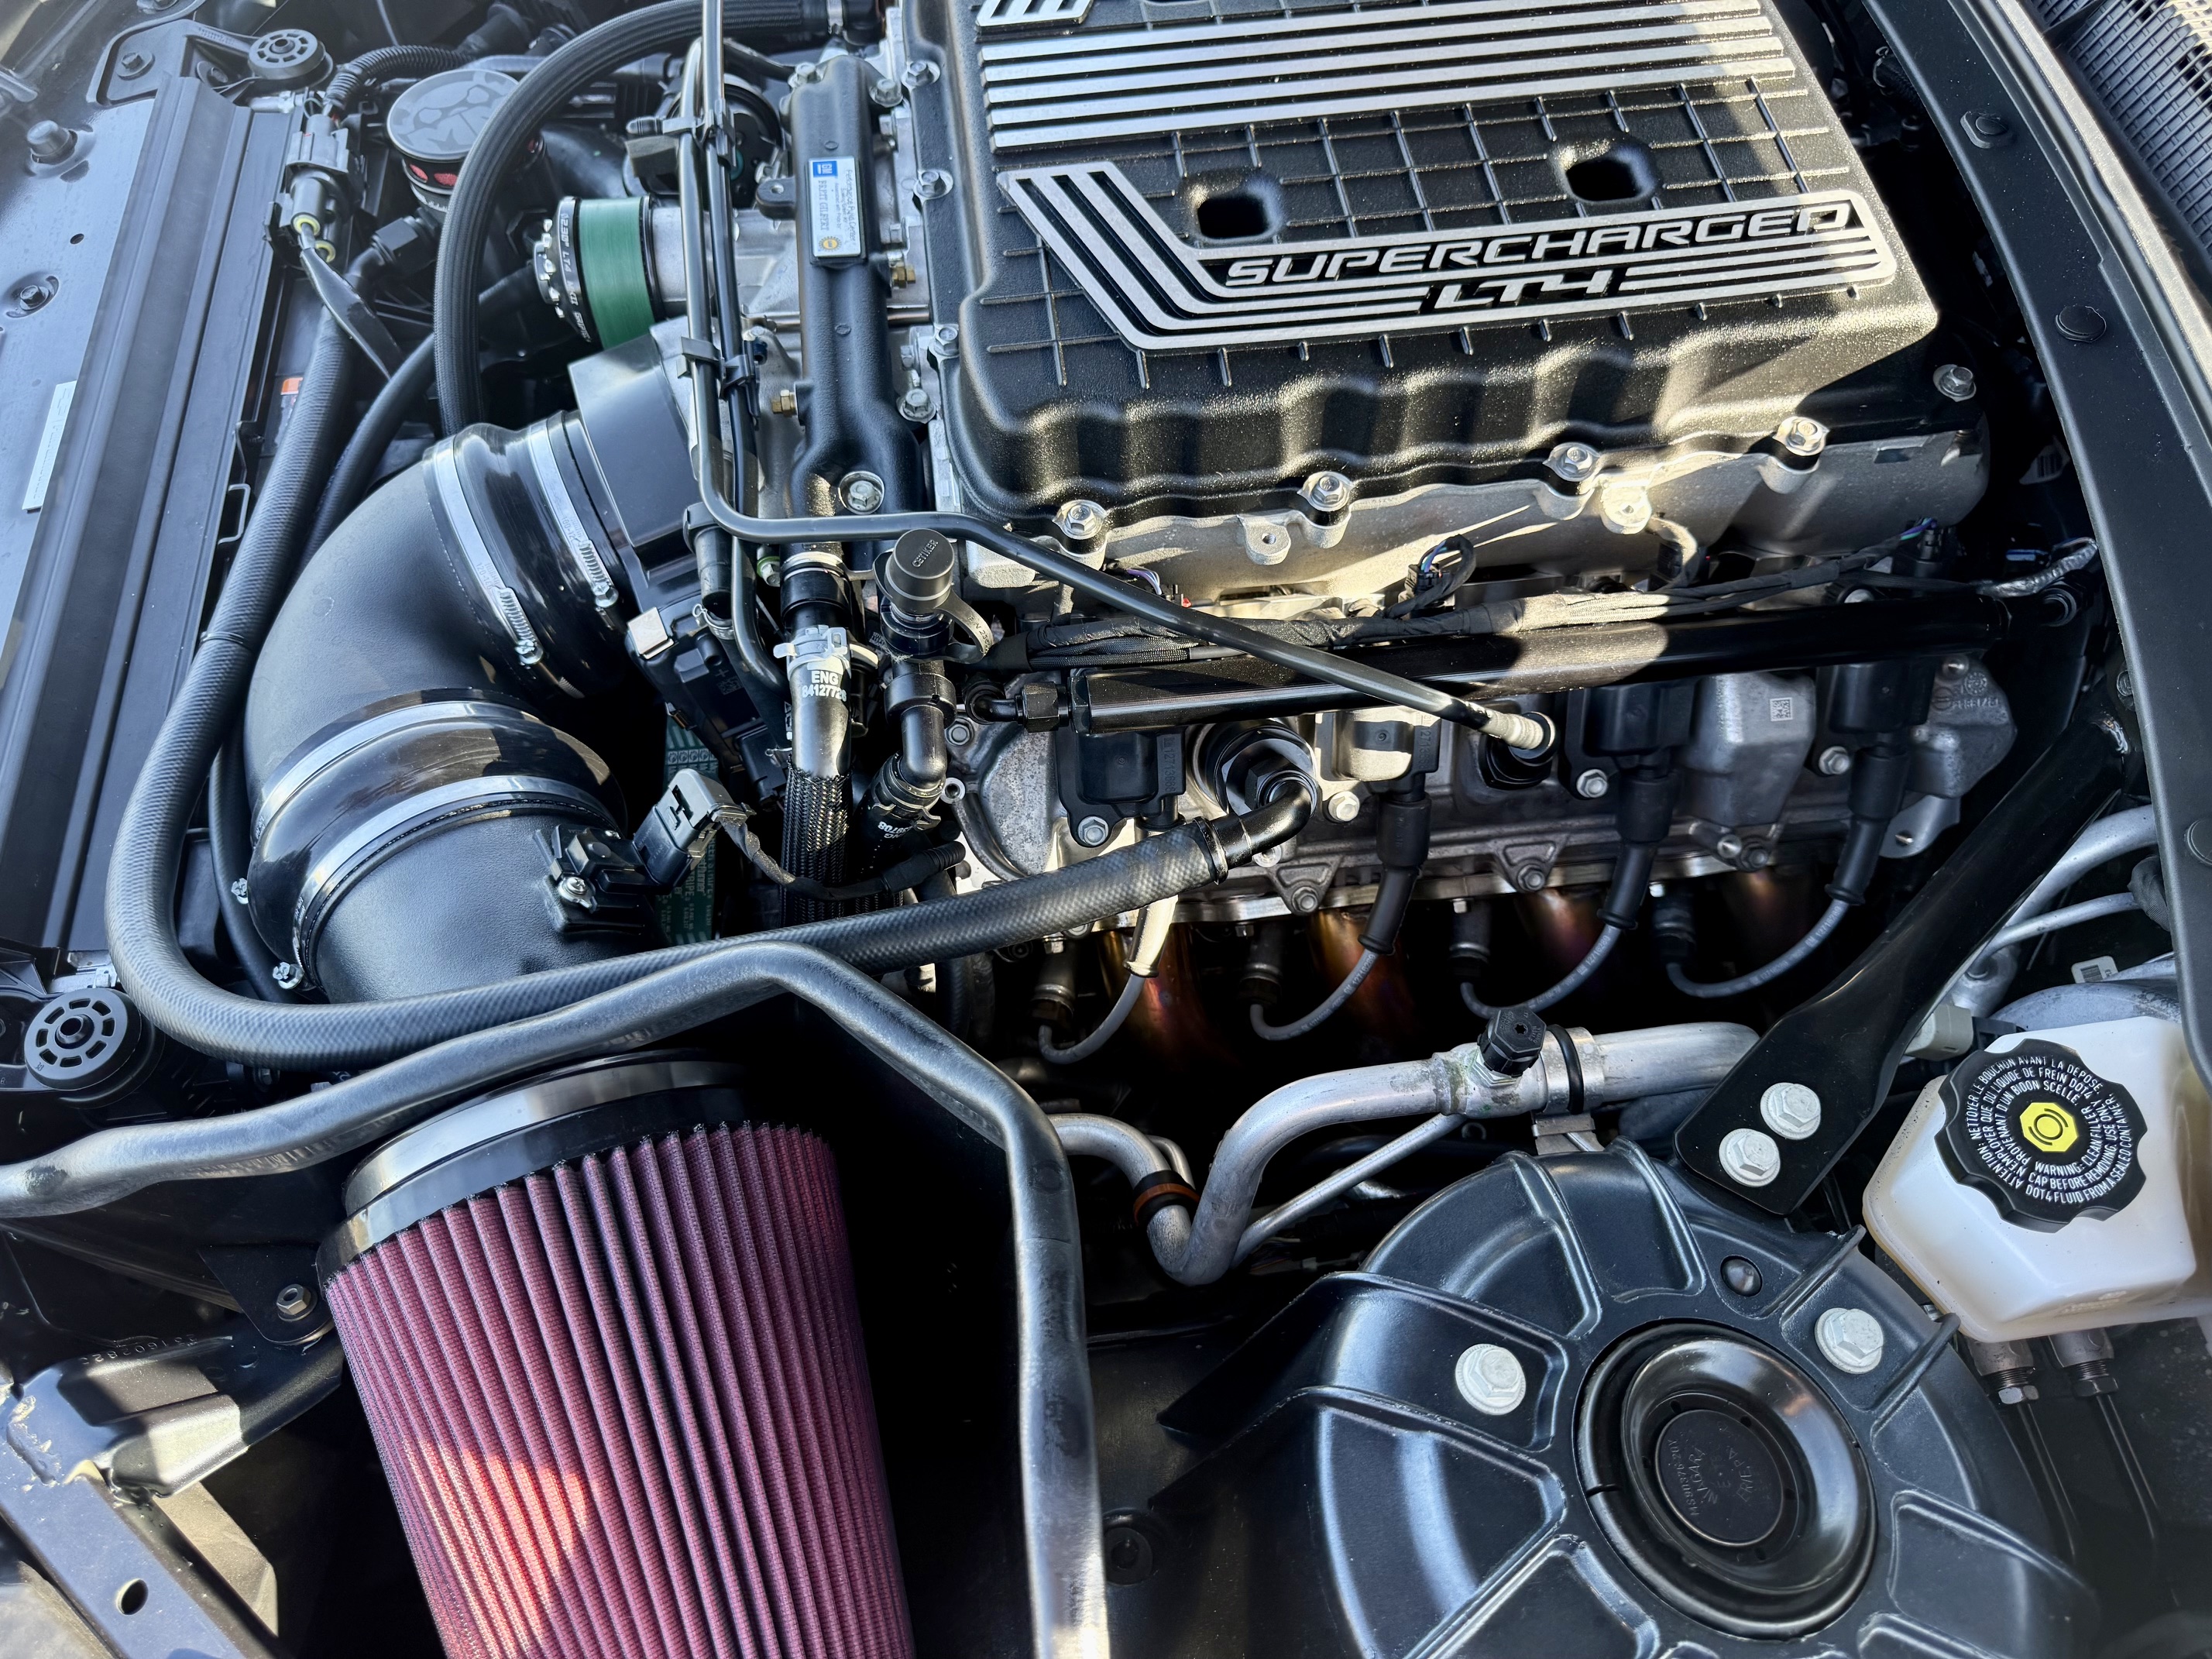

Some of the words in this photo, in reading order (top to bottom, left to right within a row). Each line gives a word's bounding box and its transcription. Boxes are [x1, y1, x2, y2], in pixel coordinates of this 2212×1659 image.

[822, 163, 833, 174] GM
[1225, 206, 1852, 287] SUPERCHARGED
[1431, 270, 1613, 312] LT4
[811, 670, 839, 685] ENG
[2018, 1055, 2047, 1066] AVANT
[2051, 1058, 2064, 1070] LA
[1978, 1058, 2016, 1085] BOUCHON
[2021, 1066, 2035, 1078] DE
[2039, 1067, 2068, 1084] FREIN
[1990, 1069, 2022, 1094] LIQUIDE
[2010, 1080, 2041, 1096] BIDON
[2068, 1077, 2094, 1100] DOT4
[1983, 1091, 1997, 1104] DU
[2042, 1080, 2080, 1107] SCELLE.
[1966, 1094, 1983, 1140] NETTOYER
[1980, 1104, 1994, 1123] QUE
[2090, 1099, 2113, 1122] ONLY
[2080, 1105, 2103, 1139] FILLER
[2104, 1092, 2133, 1149] CONTAINER.
[1994, 1114, 2032, 1166] PROVENANT
[2102, 1123, 2118, 1142] USE
[2080, 1139, 2103, 1166] CLEAN
[1977, 1142, 2025, 1189] ATTENTION:
[2034, 1160, 2086, 1176] WARNING:
[2109, 1148, 2132, 1182] SEALED
[2028, 1172, 2049, 1187] CAP
[2049, 1176, 2090, 1191] BEFORE
[2106, 1176, 2118, 1189] A
[2025, 1184, 2053, 1202] DOT4
[2053, 1190, 2084, 1204] FLUID
[2082, 1180, 2112, 1201] FROM
